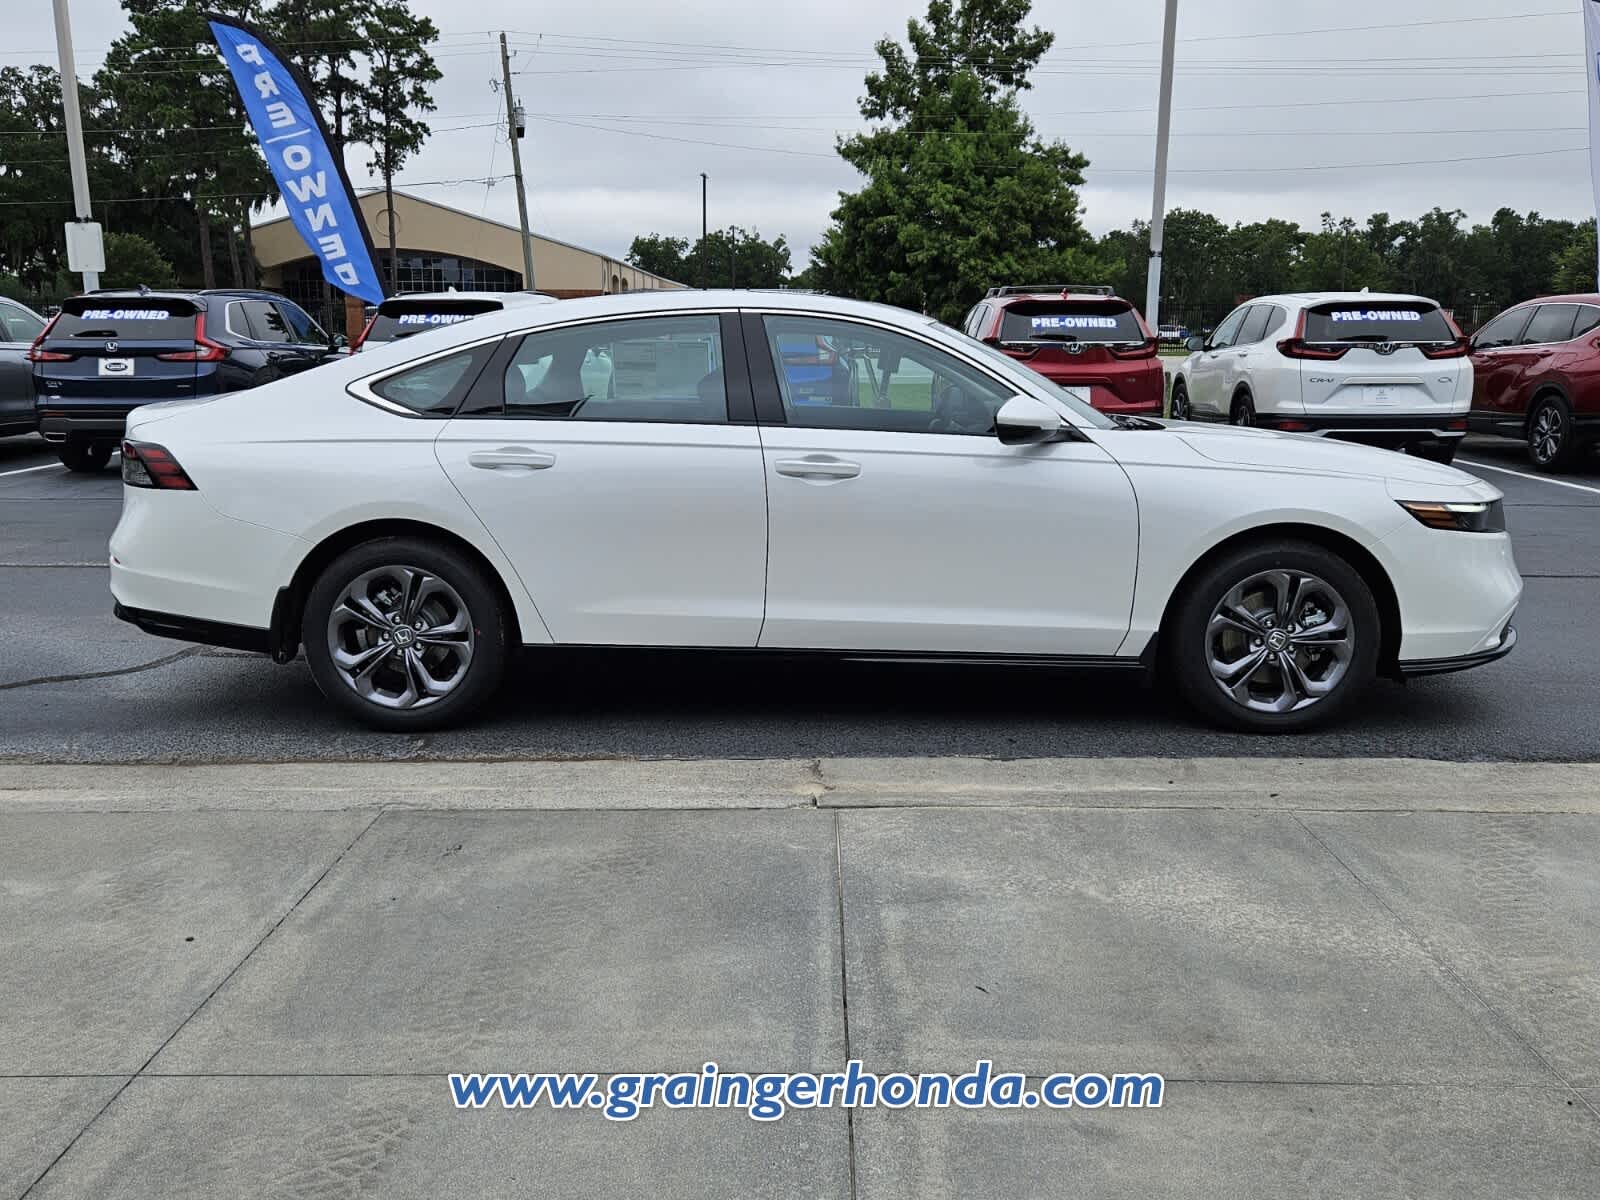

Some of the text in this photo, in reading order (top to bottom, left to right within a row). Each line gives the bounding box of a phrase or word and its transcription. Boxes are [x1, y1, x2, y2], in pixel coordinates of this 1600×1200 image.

[80, 309, 170, 321] PRE-OWNED
[1331, 311, 1421, 321] PRE-OWNED
[1031, 317, 1117, 328] PRE-OWNED
